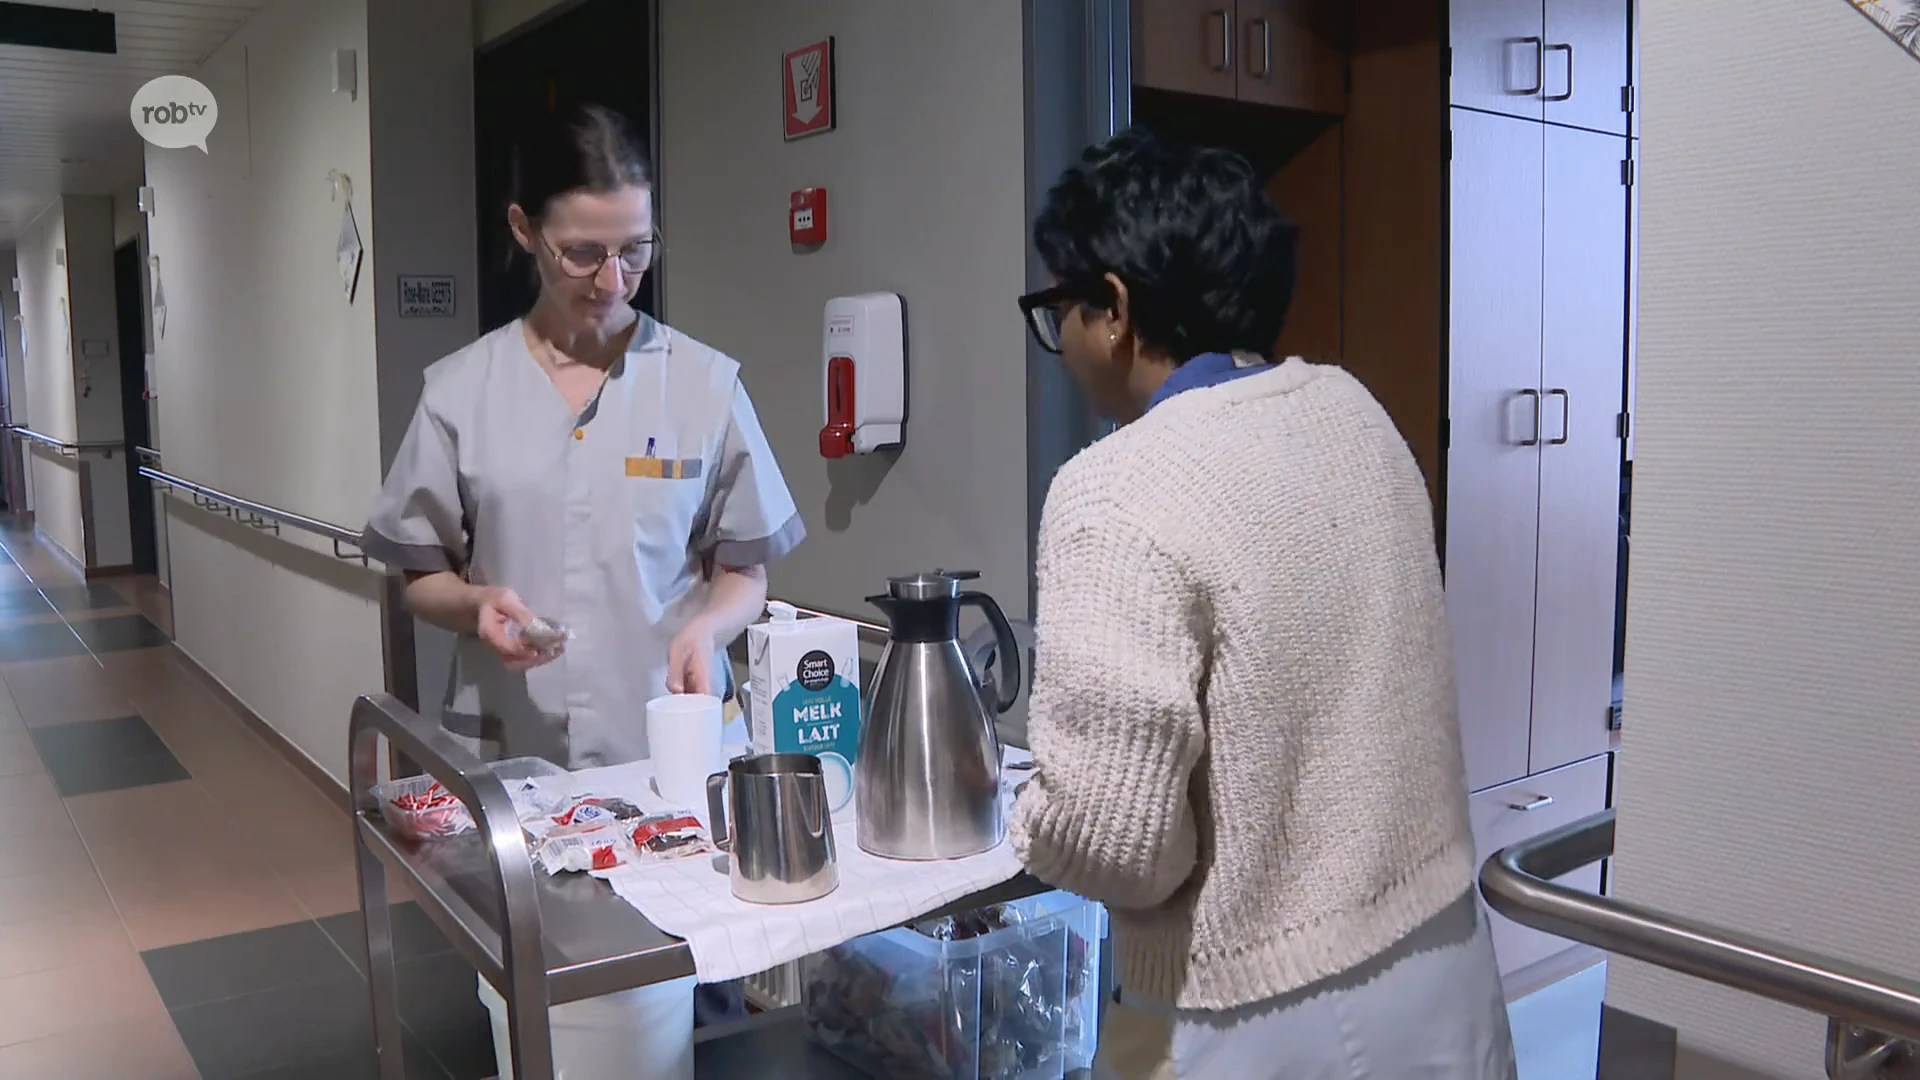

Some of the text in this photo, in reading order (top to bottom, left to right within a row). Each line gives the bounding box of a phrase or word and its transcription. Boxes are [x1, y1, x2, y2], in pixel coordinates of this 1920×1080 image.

[803, 658, 828, 669] Smart
[803, 668, 829, 678] Choice
[793, 702, 842, 723] MELK
[798, 723, 840, 745] LAIT
